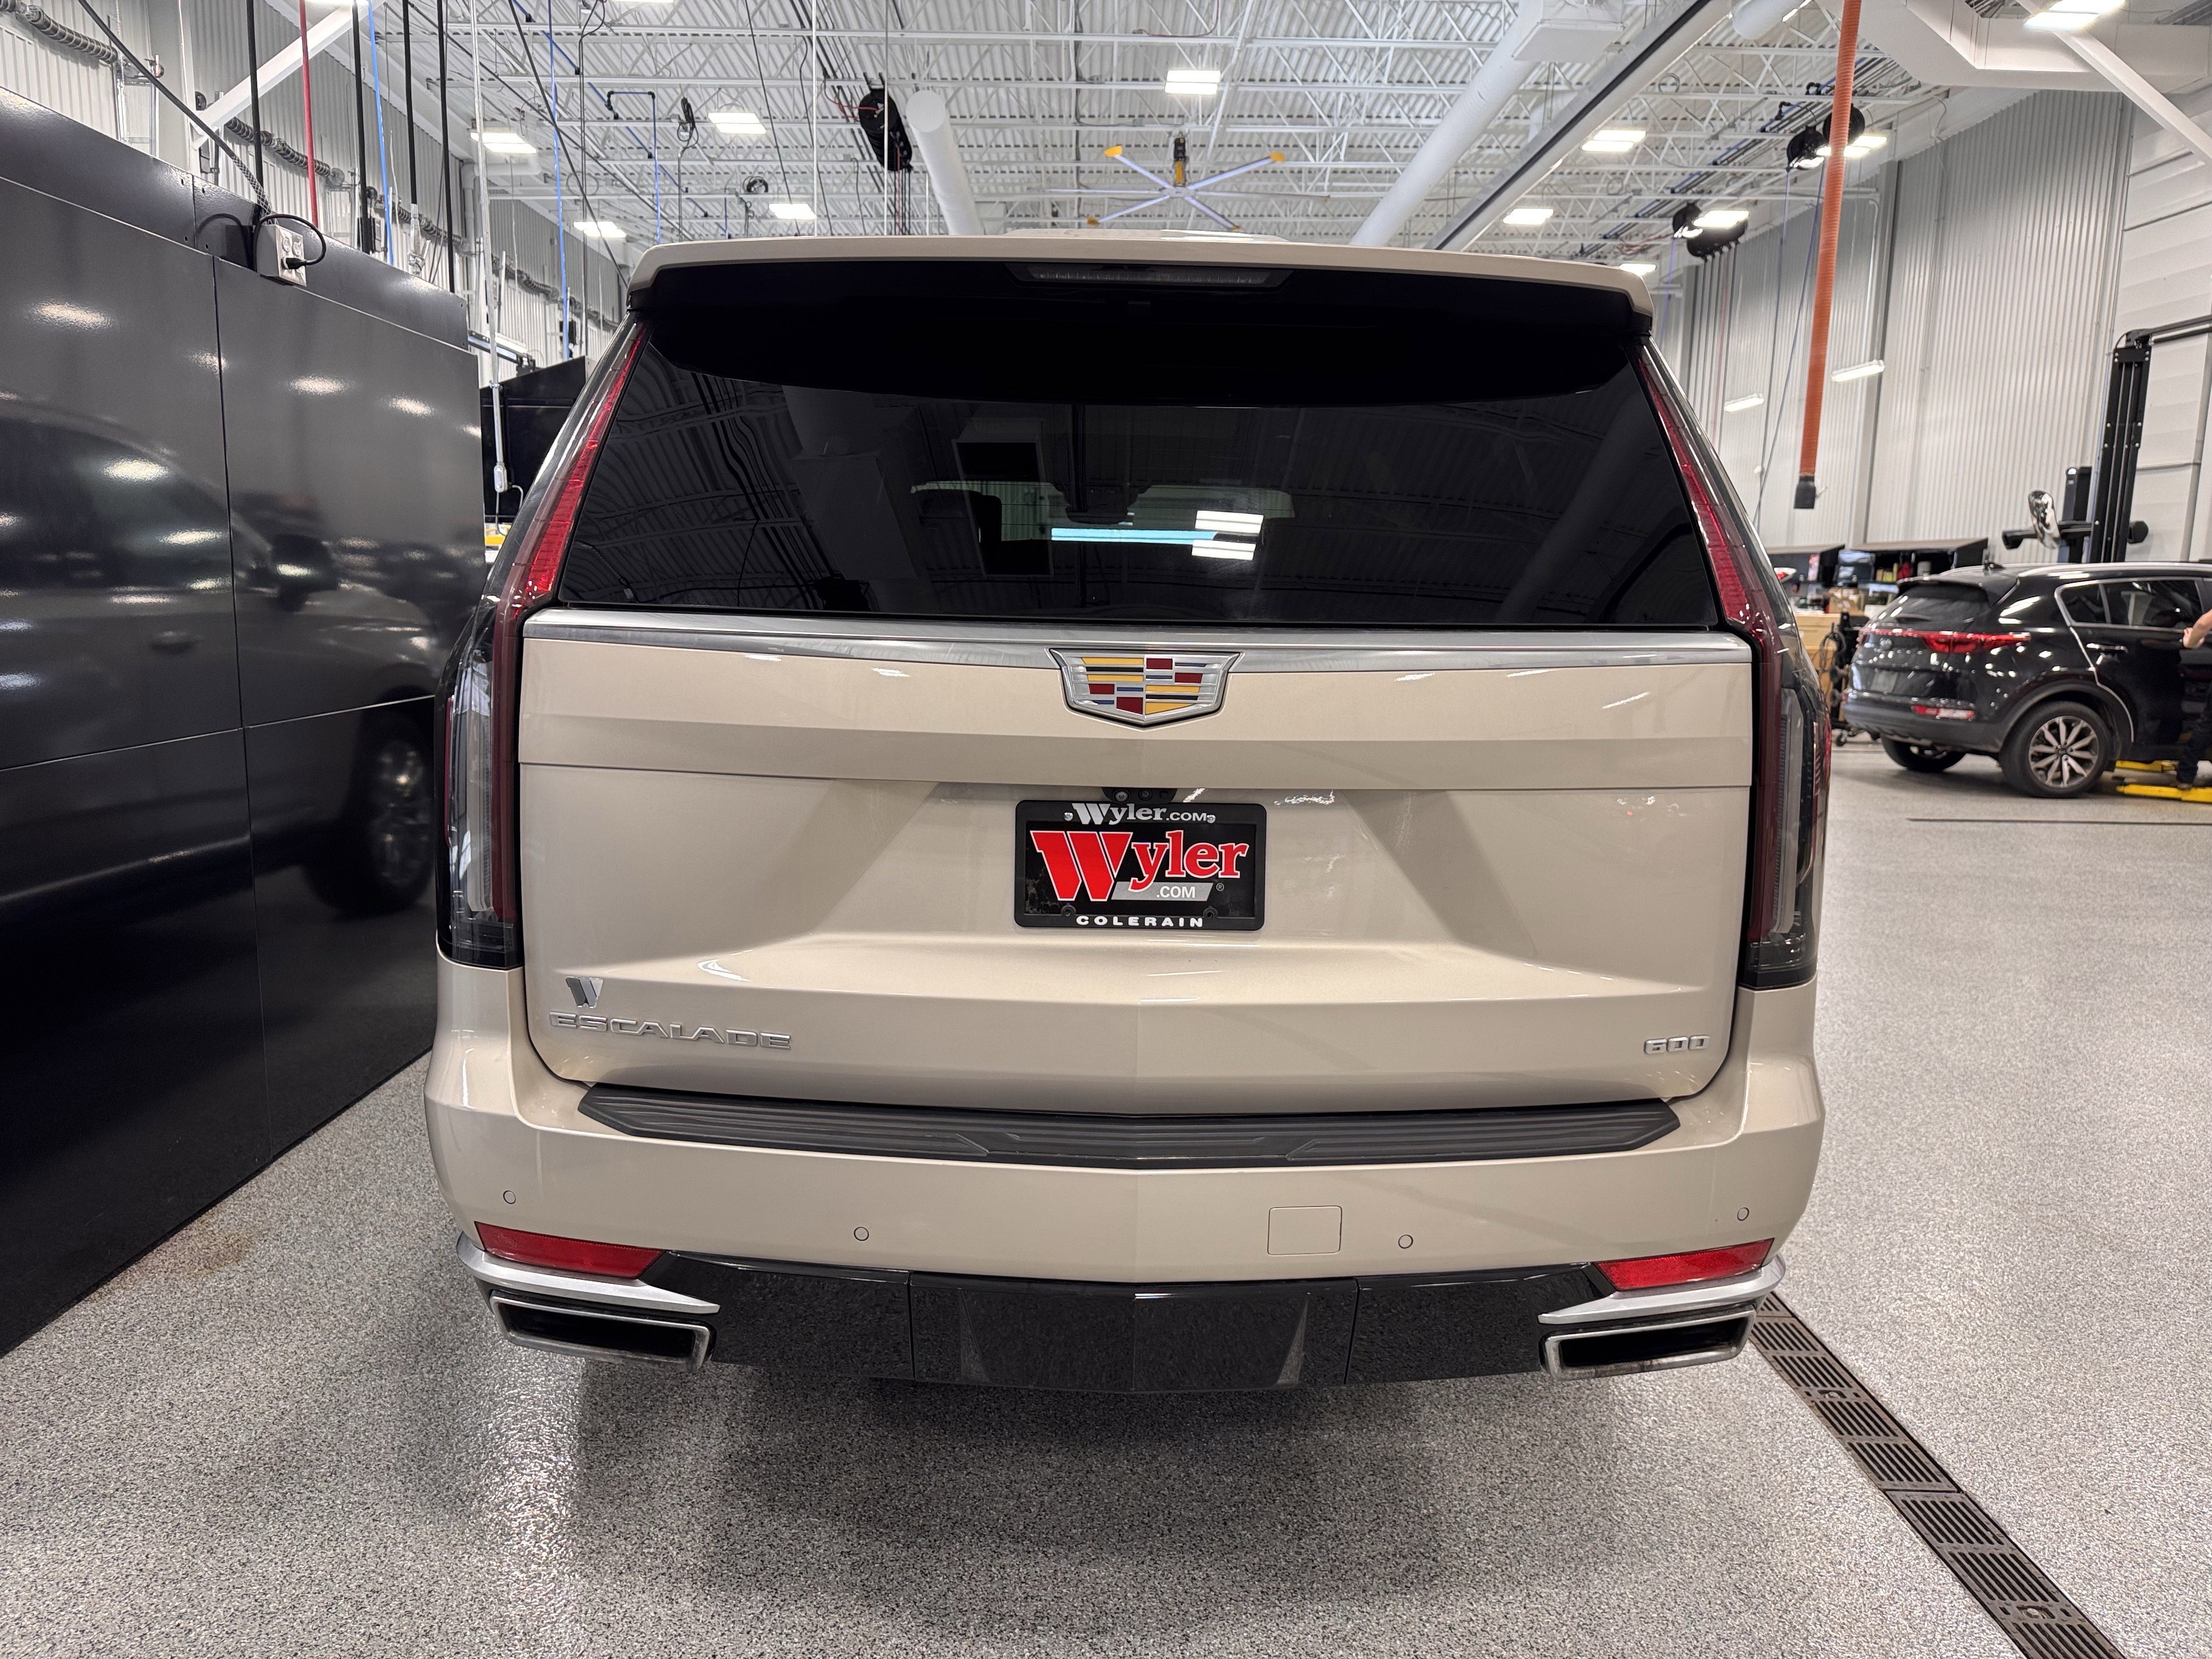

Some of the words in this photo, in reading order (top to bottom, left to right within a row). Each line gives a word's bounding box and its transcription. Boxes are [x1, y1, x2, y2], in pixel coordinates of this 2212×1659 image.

[1030, 830, 1250, 902] Wyler
[1156, 885, 1196, 899] .COM
[1076, 915, 1203, 928] COLERAIN
[549, 1011, 791, 1049] ESCALADE
[1644, 1034, 1710, 1054] 600
